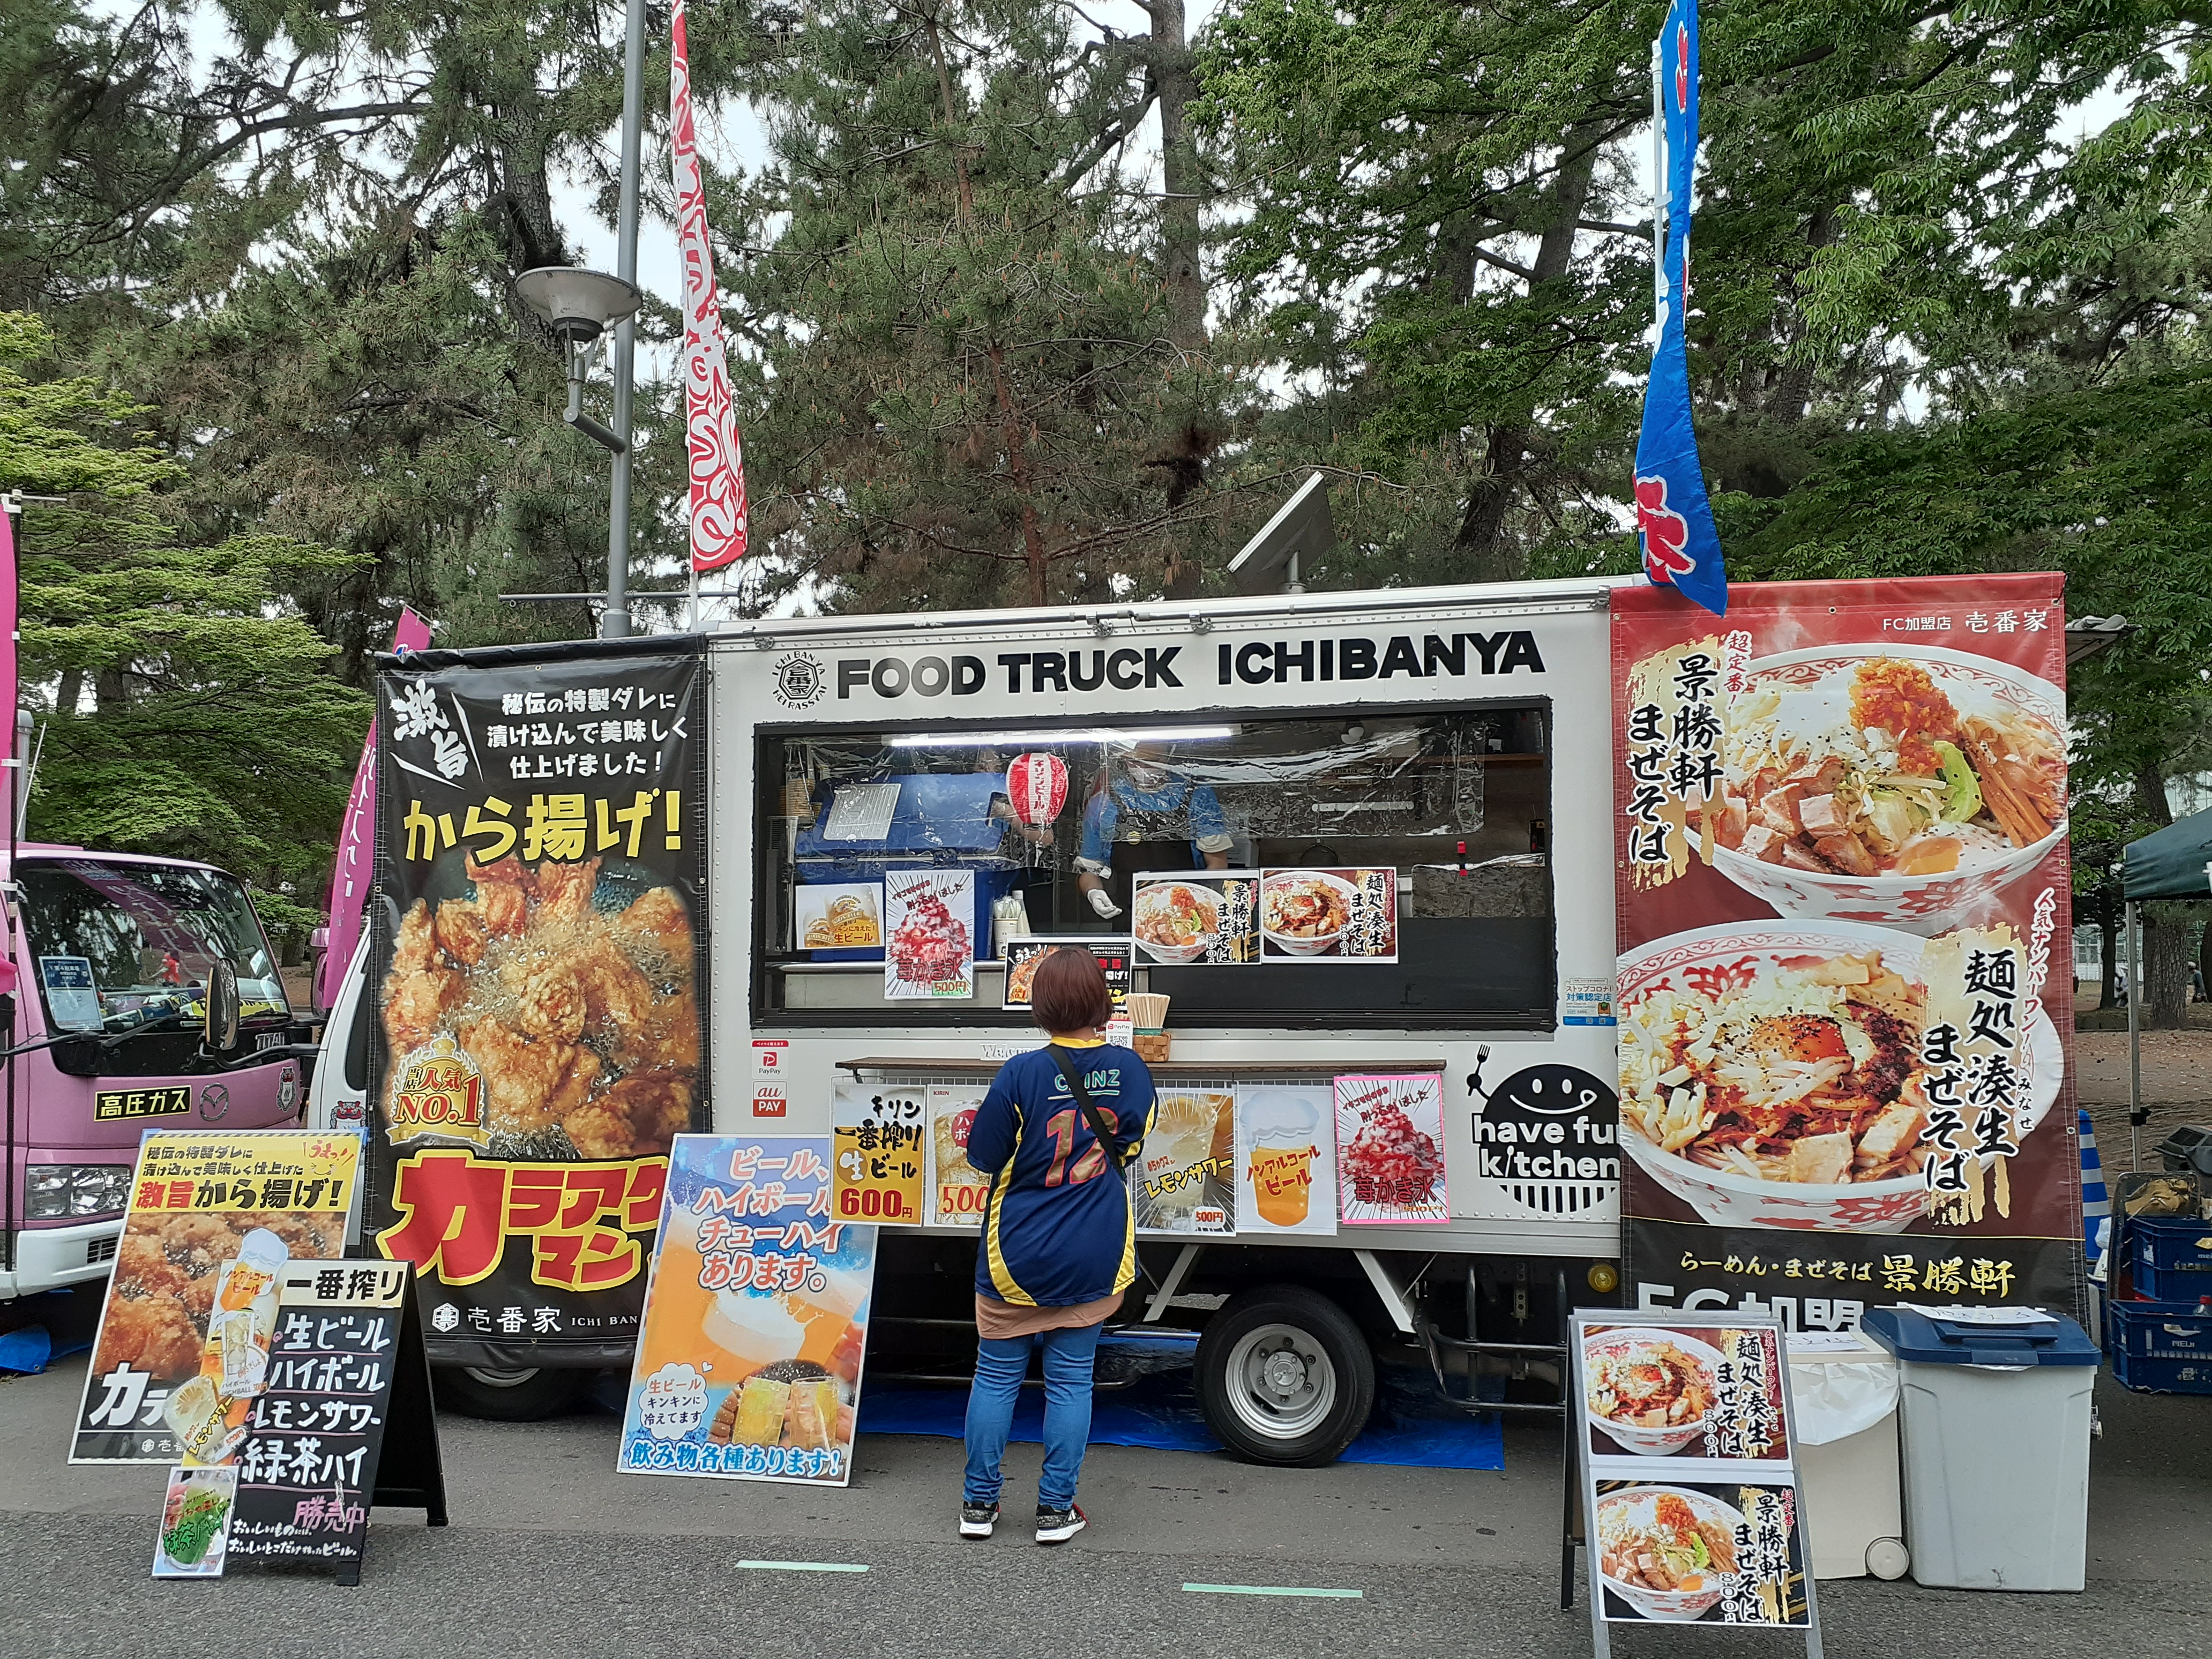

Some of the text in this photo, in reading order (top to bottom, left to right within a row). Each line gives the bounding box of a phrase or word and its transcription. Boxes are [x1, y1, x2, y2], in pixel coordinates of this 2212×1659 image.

[1883, 609, 2049, 635] FC加盟店 壱番家
[837, 630, 1546, 699] FOOD TRUCK ICHIBANYA
[502, 686, 676, 716] 秘伝の特製ダレに
[772, 685, 827, 711] HEIRASSYAI
[389, 678, 470, 779] 激旨
[487, 716, 689, 749] 漬け込んで美味しく
[1669, 652, 1725, 803] 景勝軒
[1034, 759, 1045, 810] キリンビール
[1627, 703, 1670, 864] まぜそば
[402, 788, 682, 864] から揚げ!
[1232, 883, 1250, 939] 景勝軒
[1350, 892, 1367, 954] まぜそば
[834, 932, 873, 944] 生ビール
[1216, 902, 1232, 963] まぜそば
[934, 981, 968, 992] 500円
[1566, 992, 1612, 1002] 対策認定店
[758, 1087, 783, 1097] au
[1055, 1070, 1120, 1091] CINZ
[101, 1090, 186, 1117] 高圧ガス
[394, 1075, 480, 1125] NO.1
[759, 1101, 781, 1112] PAY
[871, 1095, 922, 1119] キリン
[1922, 1026, 1970, 1192] まぜそば
[2018, 1076, 2034, 1130] みなせ
[835, 1118, 923, 1152] 一番搾り
[1045, 1107, 1118, 1187] 12
[1474, 1115, 1620, 1145] have fu
[143, 1161, 303, 1177] 漬け込んで美味しく仕上げた
[146, 1146, 253, 1160] 秘伝の特製ダレに
[1246, 1144, 1321, 1183] ノンアルコール
[136, 1178, 343, 1209] 激旨から揚げ!
[1143, 1156, 1234, 1200] レモンサワー
[1265, 1168, 1313, 1196] ビール
[840, 1188, 914, 1219] 600円
[1195, 1210, 1224, 1223] 500円
[698, 1216, 843, 1252] チューハイ
[534, 1232, 638, 1288] マン
[701, 1252, 828, 1291] あります。
[1879, 1253, 2017, 1298] 景勝軒
[232, 1281, 261, 1296] ビール
[286, 1268, 405, 1302] 一番搾り
[283, 1312, 392, 1351] 生ビール
[468, 1306, 562, 1334] 壱番家
[571, 1316, 602, 1327] ICHI
[222, 1379, 251, 1388] ハイボール
[270, 1356, 385, 1392] ハイボール
[648, 1378, 701, 1394] 生ビール
[88, 1362, 169, 1426] カラ
[647, 1395, 701, 1408] キンキンに
[1717, 1361, 1744, 1453] まぜそば
[188, 1396, 234, 1456] レモンサワー
[254, 1398, 381, 1432] レモンサワー
[643, 1411, 702, 1426] 冷えてます
[241, 1438, 368, 1487] 緑茶ハイ
[1755, 1494, 1790, 1586] 景勝軒
[1734, 1522, 1765, 1622] まぜそば
